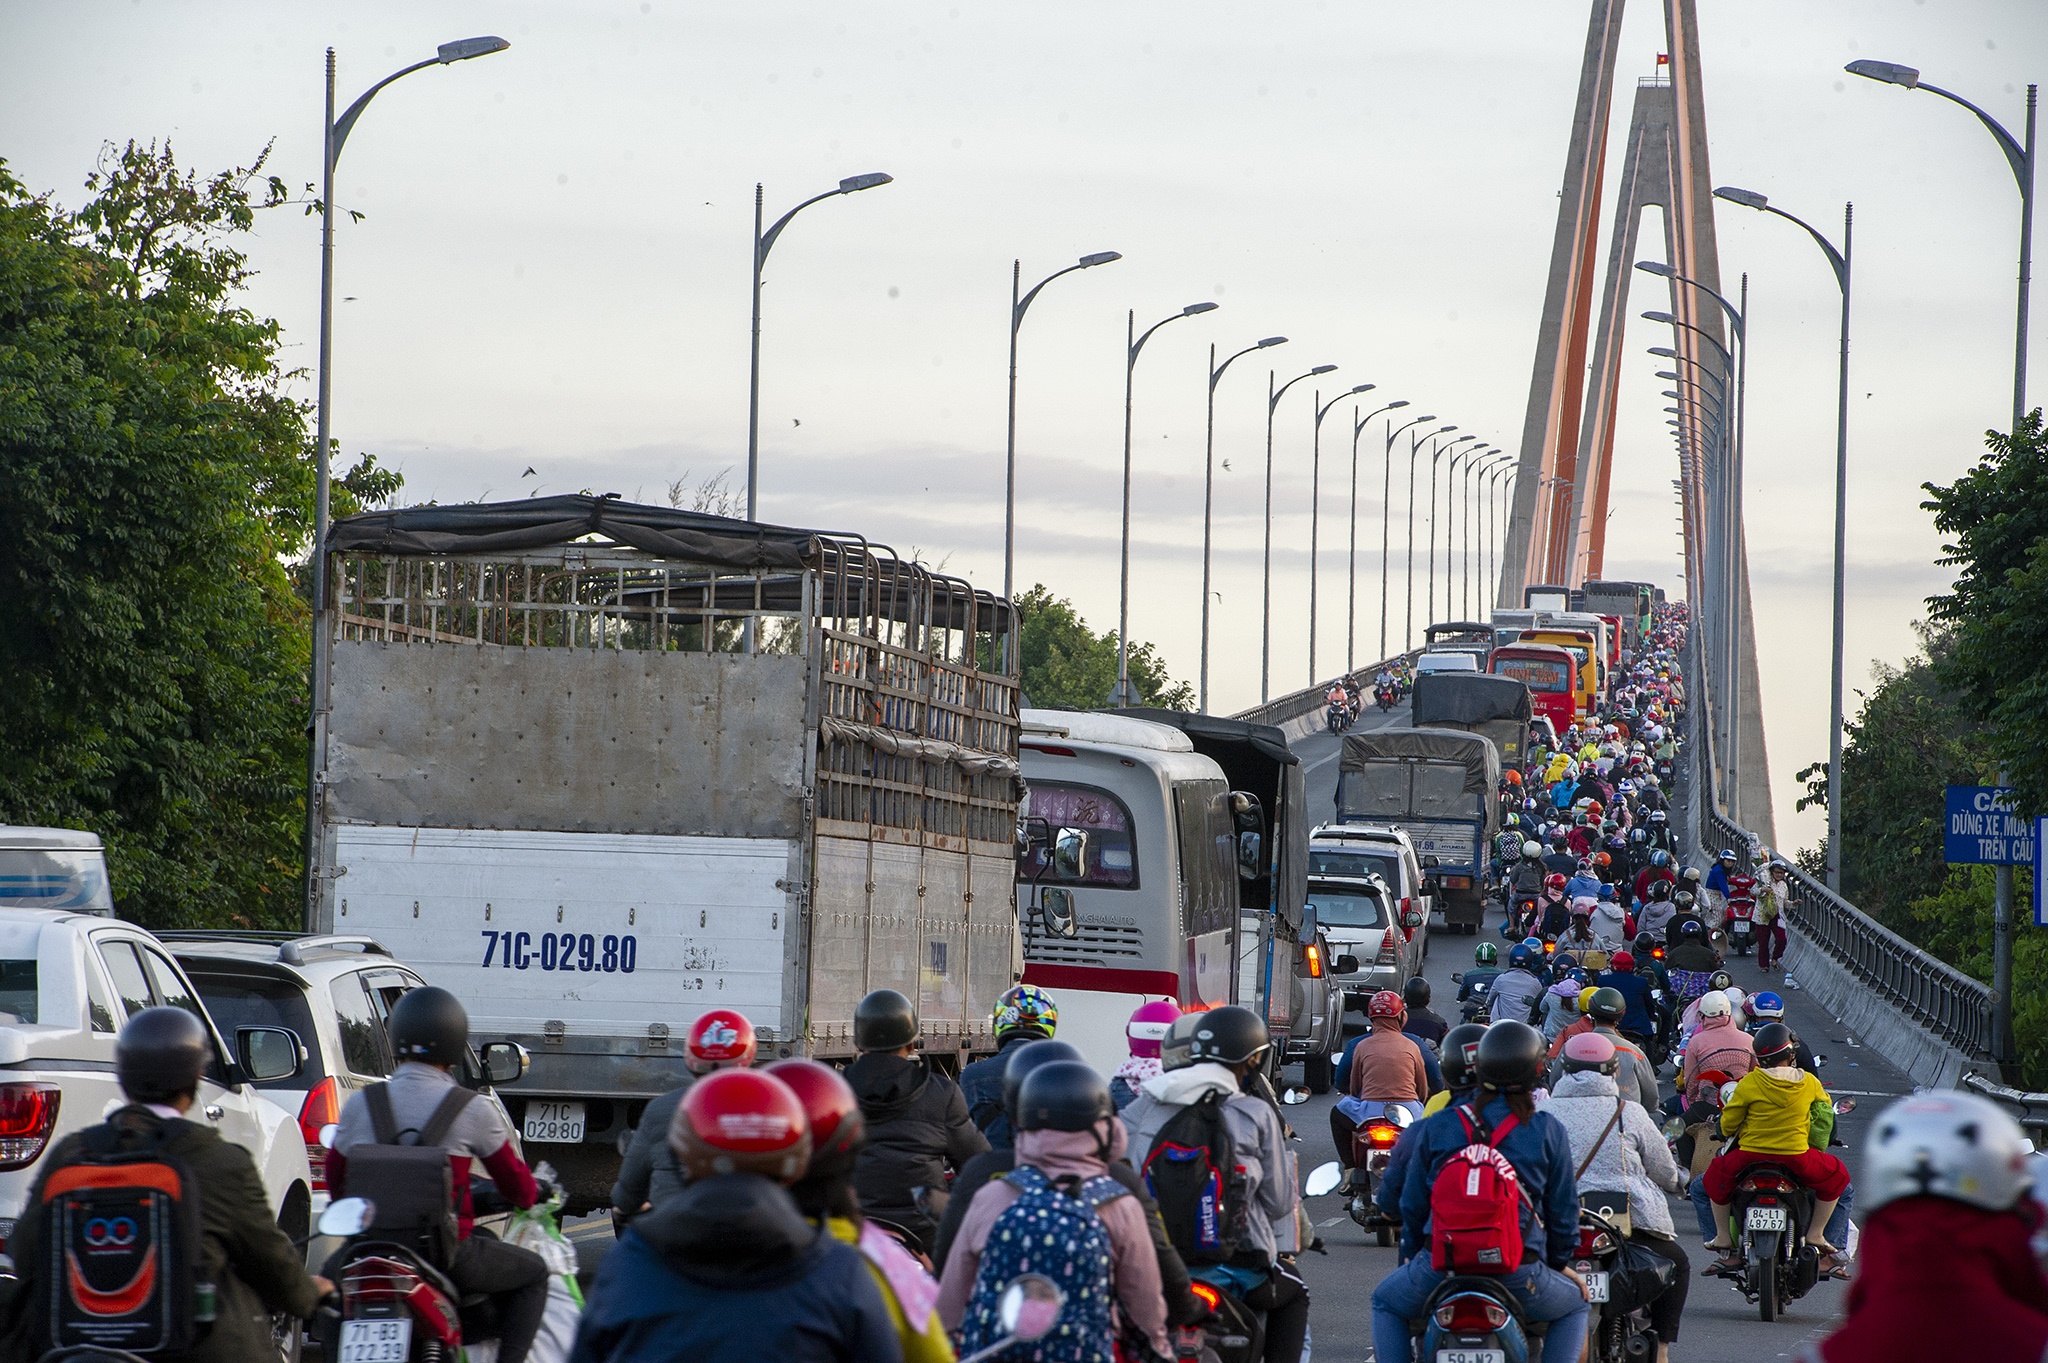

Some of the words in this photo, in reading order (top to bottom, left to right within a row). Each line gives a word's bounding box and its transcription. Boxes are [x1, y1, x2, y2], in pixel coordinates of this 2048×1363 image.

[1503, 668, 1532, 681] MINH
[1952, 809, 1983, 835] DỪNG
[1978, 836, 2006, 860] TRÊN
[2012, 837, 2034, 861] CẦU
[481, 930, 637, 973] 71C-029.80
[540, 1103, 571, 1121] 71C
[526, 1120, 581, 1139] 029.80
[1753, 1209, 1779, 1219] 84-L1
